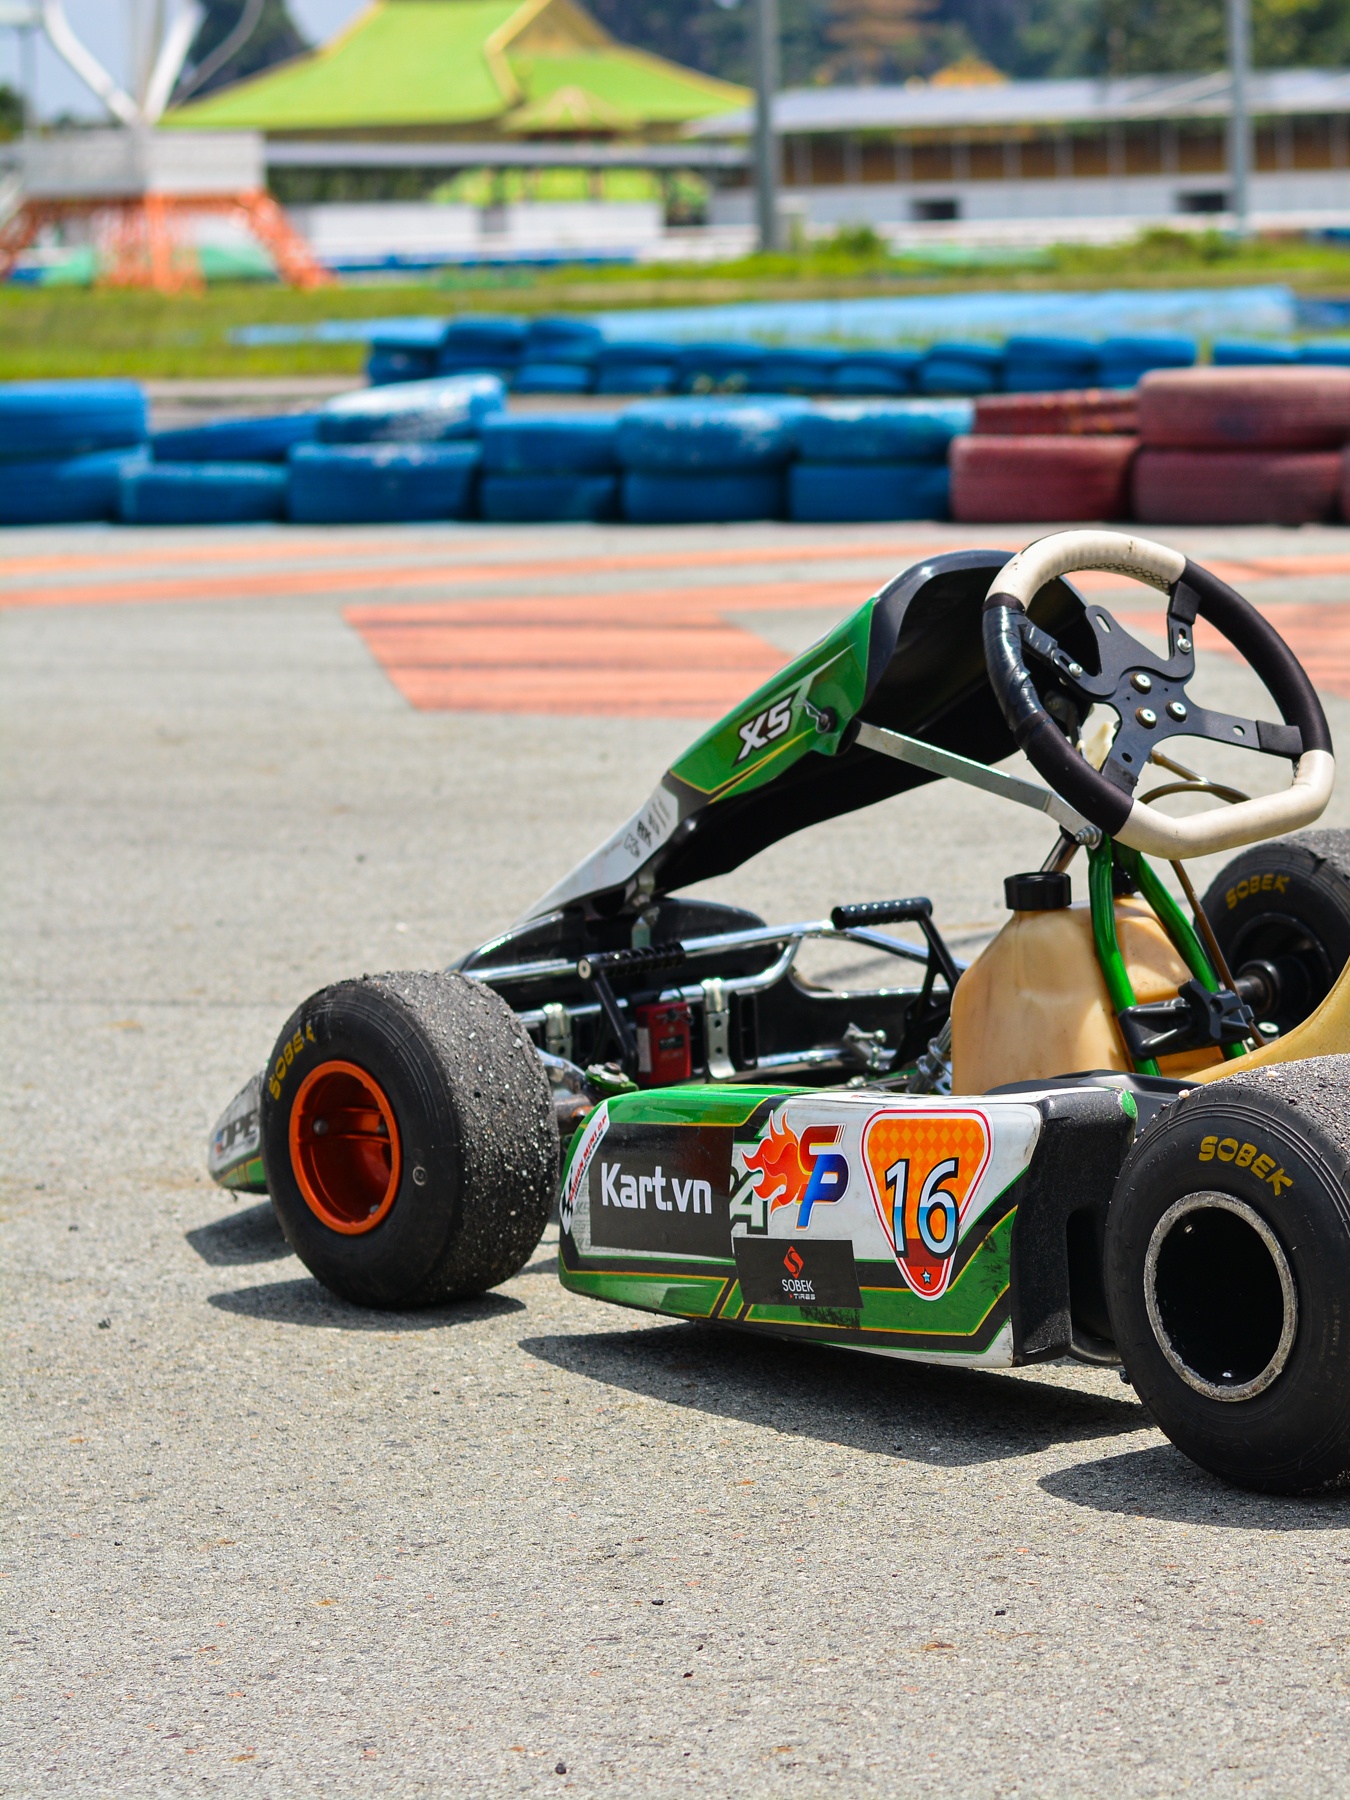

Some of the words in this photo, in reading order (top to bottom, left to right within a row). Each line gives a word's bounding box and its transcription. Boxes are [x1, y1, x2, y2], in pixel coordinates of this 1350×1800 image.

[1225, 873, 1290, 910] SOBEK
[601, 1162, 712, 1215] Kart.vn
[1198, 1135, 1293, 1196] SOBEK
[885, 1156, 959, 1260] 16
[781, 1278, 814, 1293] SOBEK
